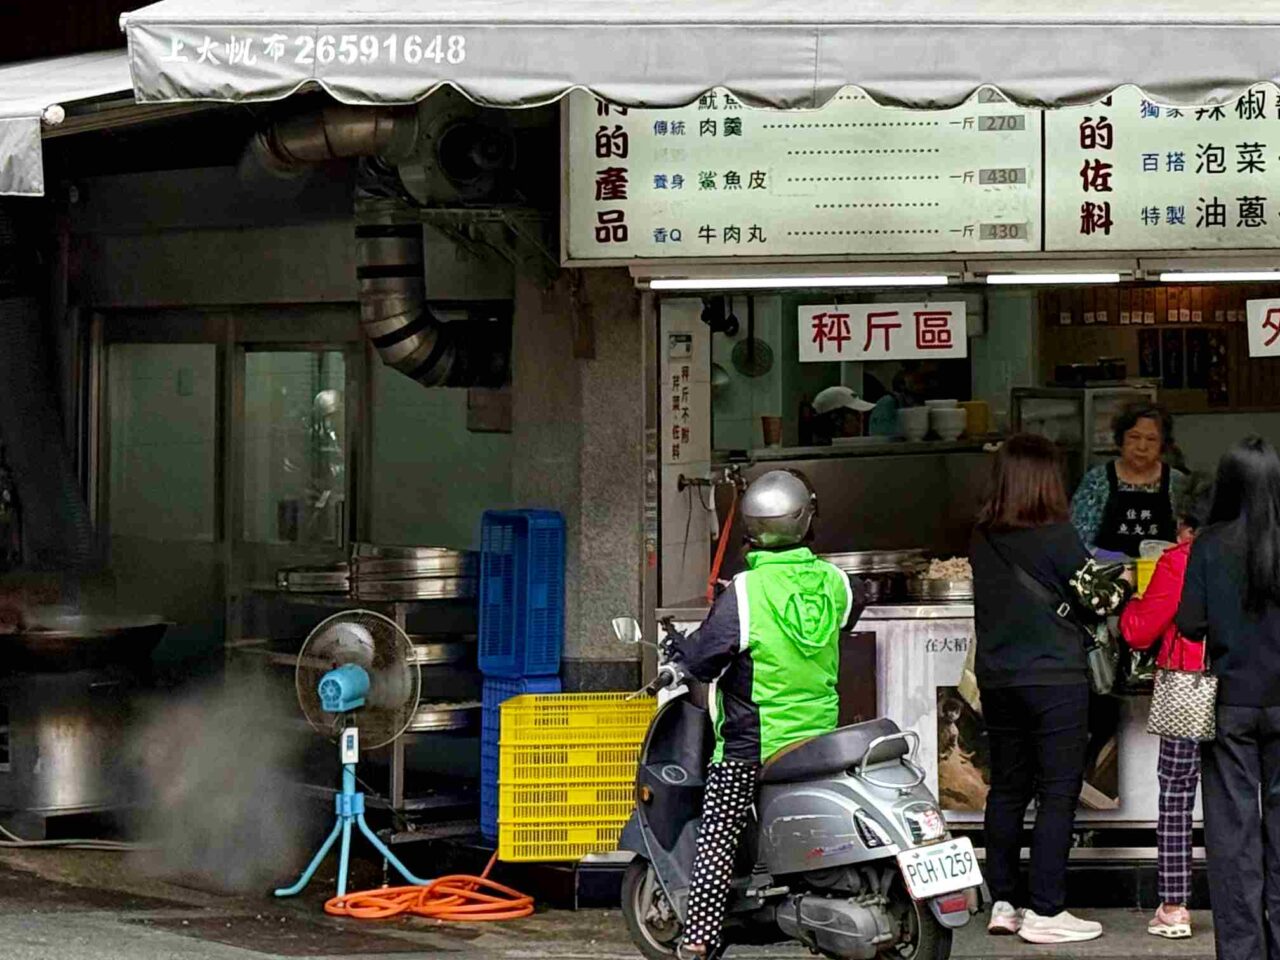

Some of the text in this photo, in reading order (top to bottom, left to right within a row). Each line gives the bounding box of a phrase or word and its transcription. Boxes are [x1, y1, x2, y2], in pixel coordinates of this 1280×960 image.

[294, 34, 466, 65] 26591648
[988, 115, 1017, 130] 270
[1079, 95, 1114, 236] 的佐料
[1142, 151, 1186, 173] 百搭
[1195, 142, 1267, 175] 泡菜
[987, 169, 1018, 184] 430
[1141, 205, 1186, 226] 特製
[698, 224, 767, 244] 牛肉丸
[988, 224, 1019, 239] 430
[812, 311, 954, 354] 秤斤區
